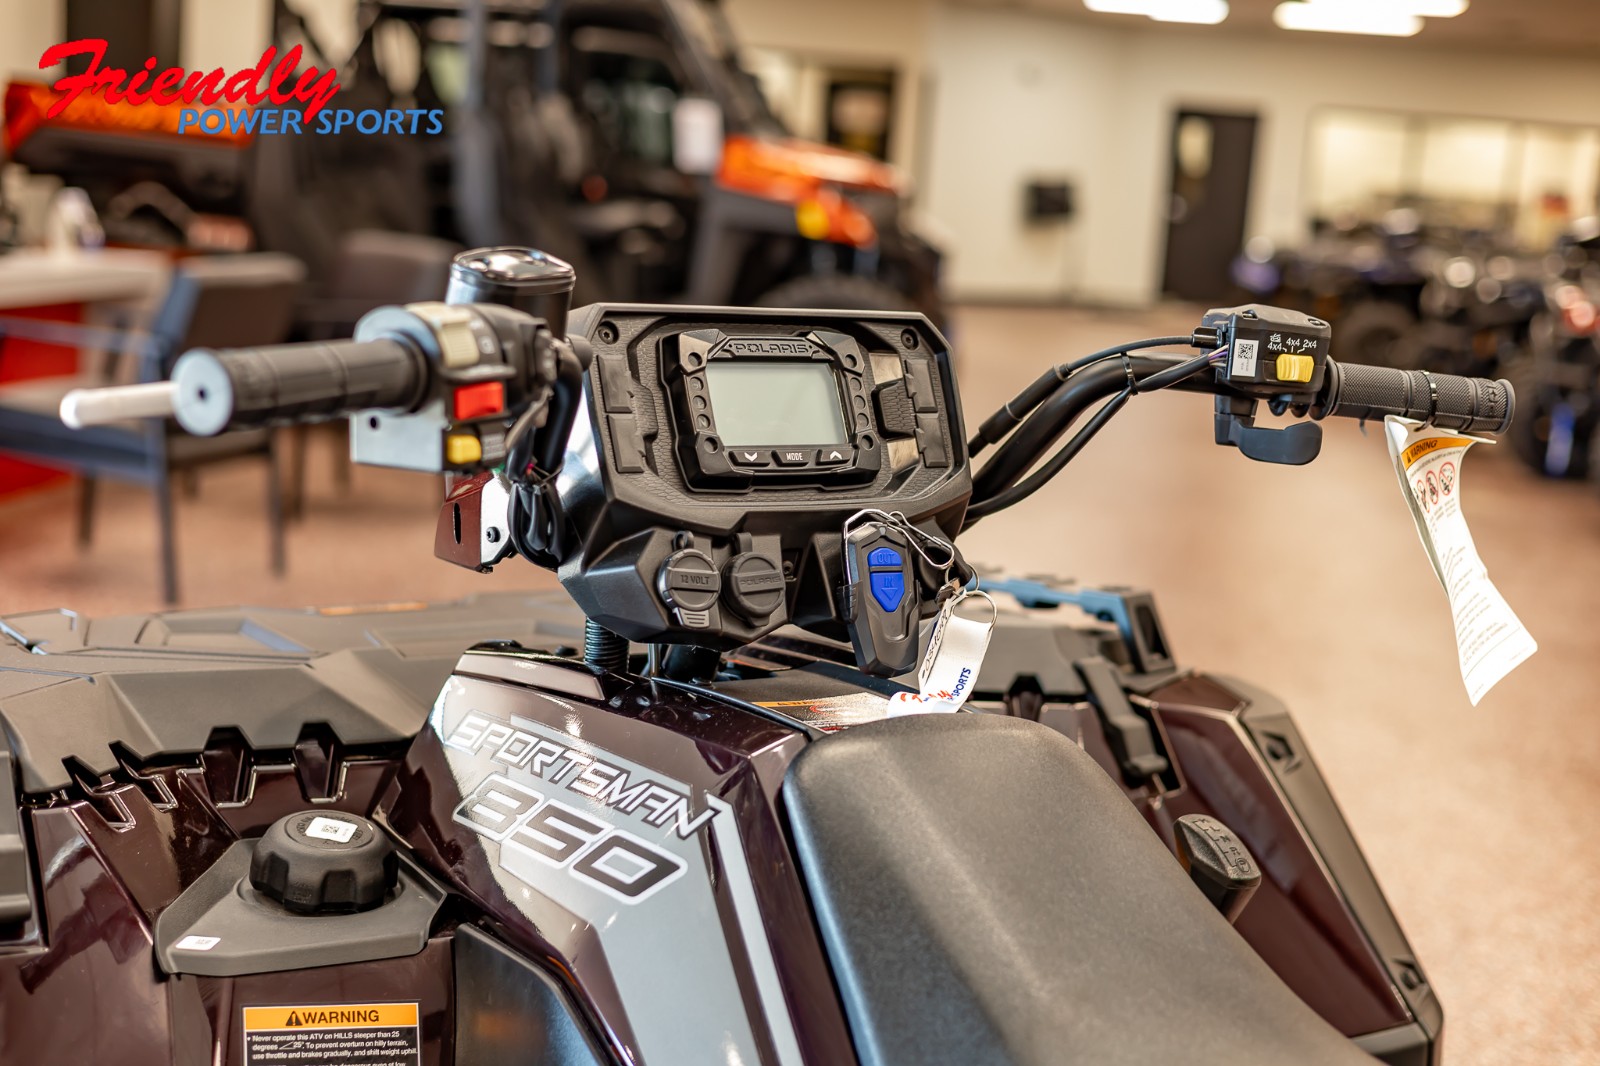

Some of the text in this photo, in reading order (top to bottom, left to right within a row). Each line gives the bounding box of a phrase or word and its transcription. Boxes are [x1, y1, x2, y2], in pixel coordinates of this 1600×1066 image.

[734, 343, 809, 353] POLARIS
[1267, 342, 1282, 351] 4x4
[1286, 338, 1317, 349] 4x4 2x4
[786, 452, 803, 461] MODE
[877, 552, 895, 564] OUT
[681, 574, 710, 585] 12 VOLT
[450, 712, 722, 840] SPORTSMAN
[453, 774, 688, 905] 850
[302, 1010, 380, 1024] WARNING
[272, 1034, 296, 1042] operate
[309, 1032, 324, 1040] ATV
[252, 1044, 278, 1052] degrees
[315, 1041, 338, 1050] prevent
[374, 1040, 386, 1048] hilly
[380, 1048, 400, 1056] weight
